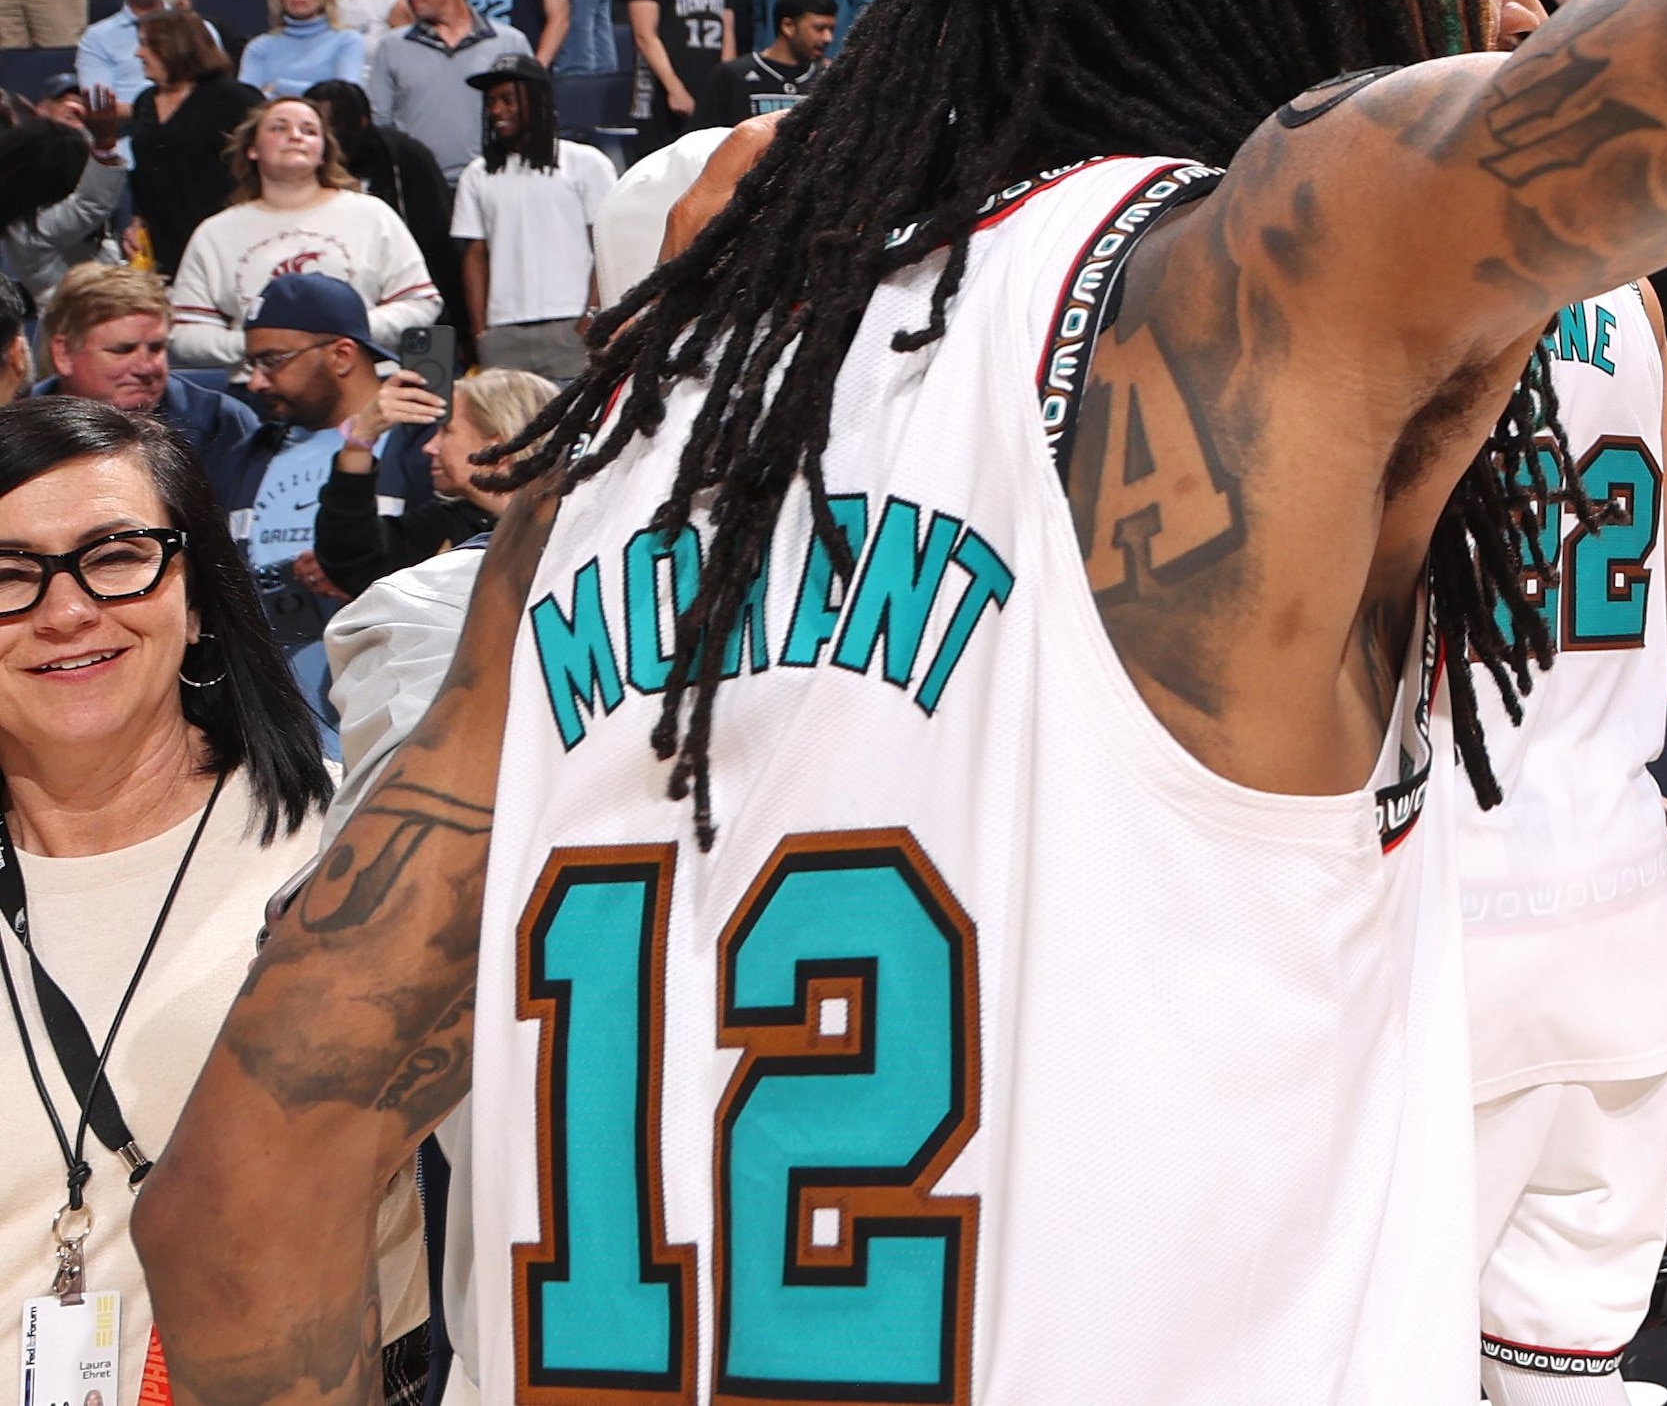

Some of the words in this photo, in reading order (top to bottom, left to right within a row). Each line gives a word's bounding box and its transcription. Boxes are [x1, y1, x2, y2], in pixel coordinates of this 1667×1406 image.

[684, 18, 723, 48] 12
[260, 527, 313, 546] GRIZZ
[511, 825, 981, 1406] 12
[79, 1359, 112, 1371] Laura
[82, 1370, 112, 1381] Ehret
